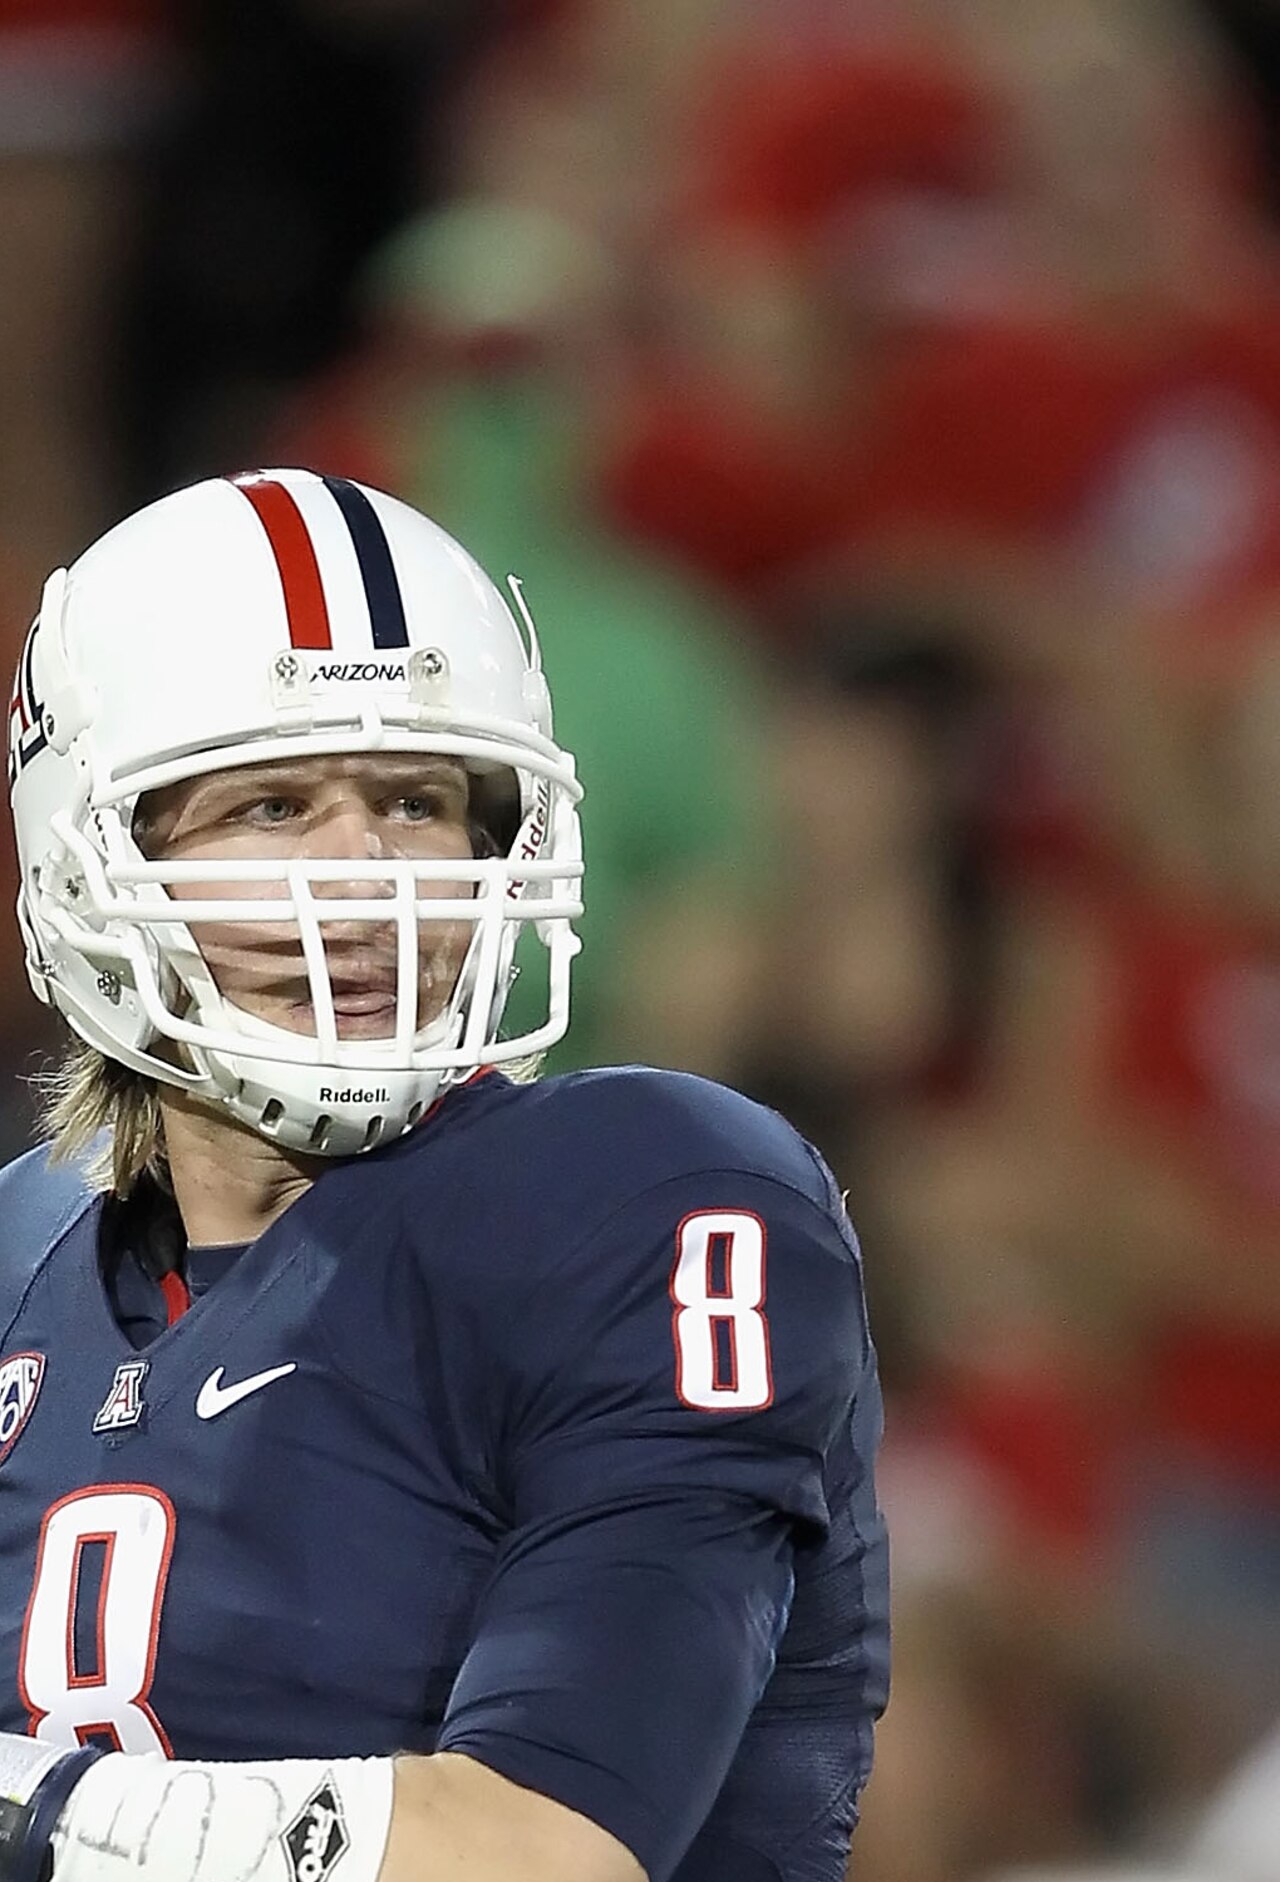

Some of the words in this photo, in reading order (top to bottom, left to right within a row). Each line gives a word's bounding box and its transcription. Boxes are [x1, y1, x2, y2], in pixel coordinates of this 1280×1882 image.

[310, 663, 405, 683] ARIZONA
[669, 1208, 774, 1412] 8
[93, 1360, 150, 1433] A
[17, 1482, 176, 1760] 8
